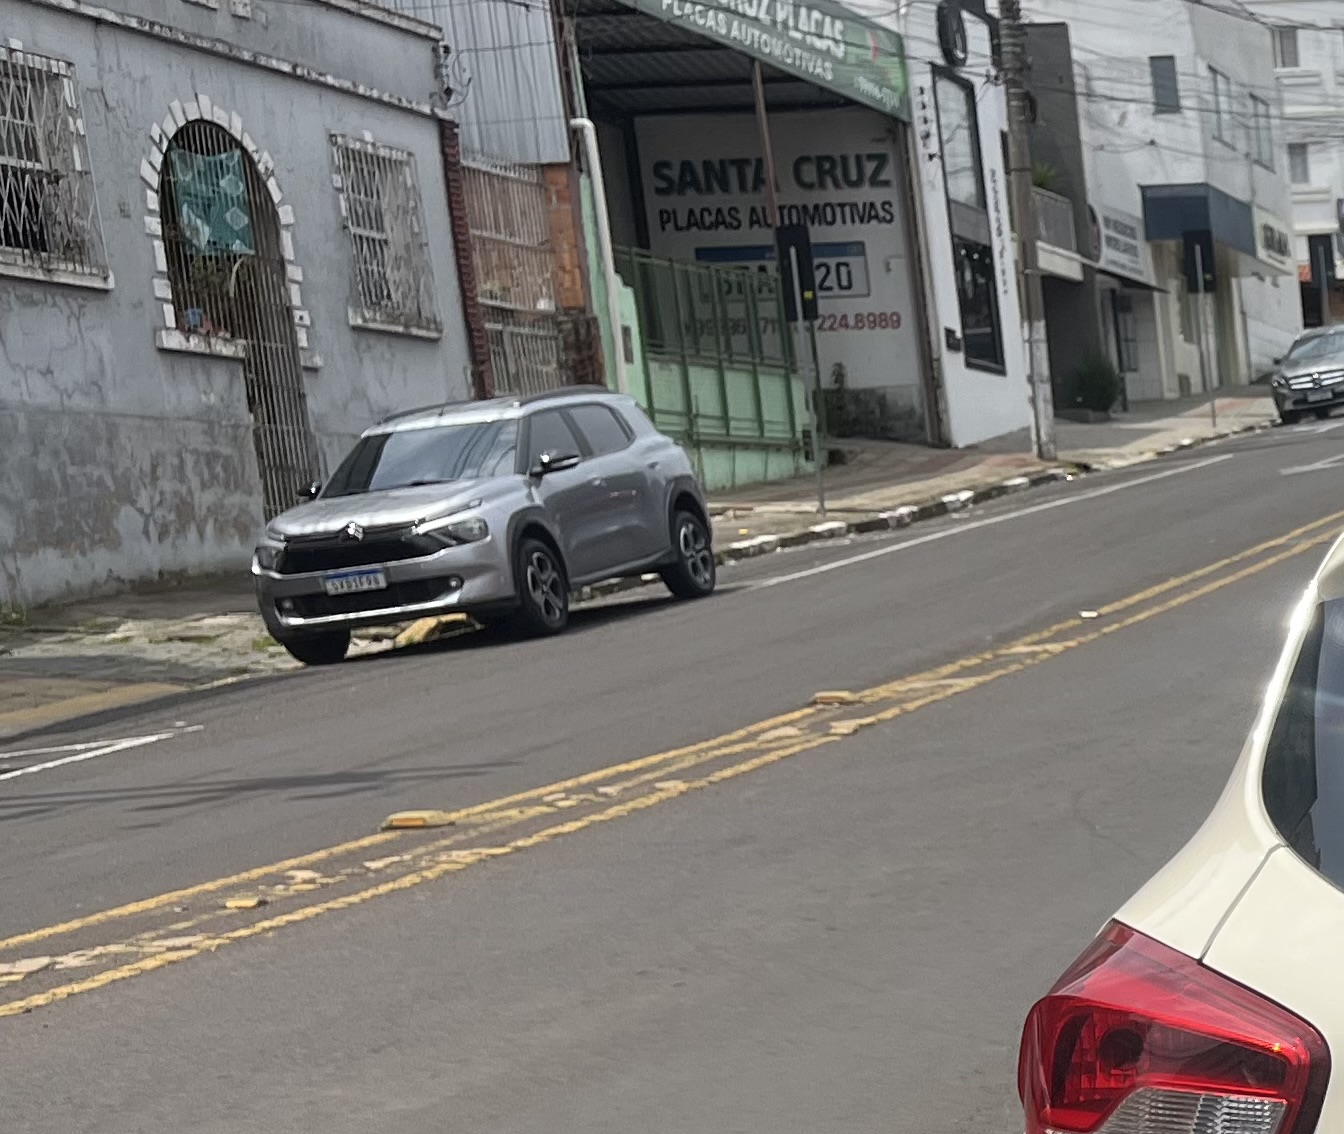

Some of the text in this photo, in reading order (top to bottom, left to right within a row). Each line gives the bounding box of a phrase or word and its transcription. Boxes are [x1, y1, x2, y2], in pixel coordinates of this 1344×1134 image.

[653, 153, 891, 196] SANTA CRUZ
[659, 201, 894, 232] PLACAS AUTOMOTIVAS
